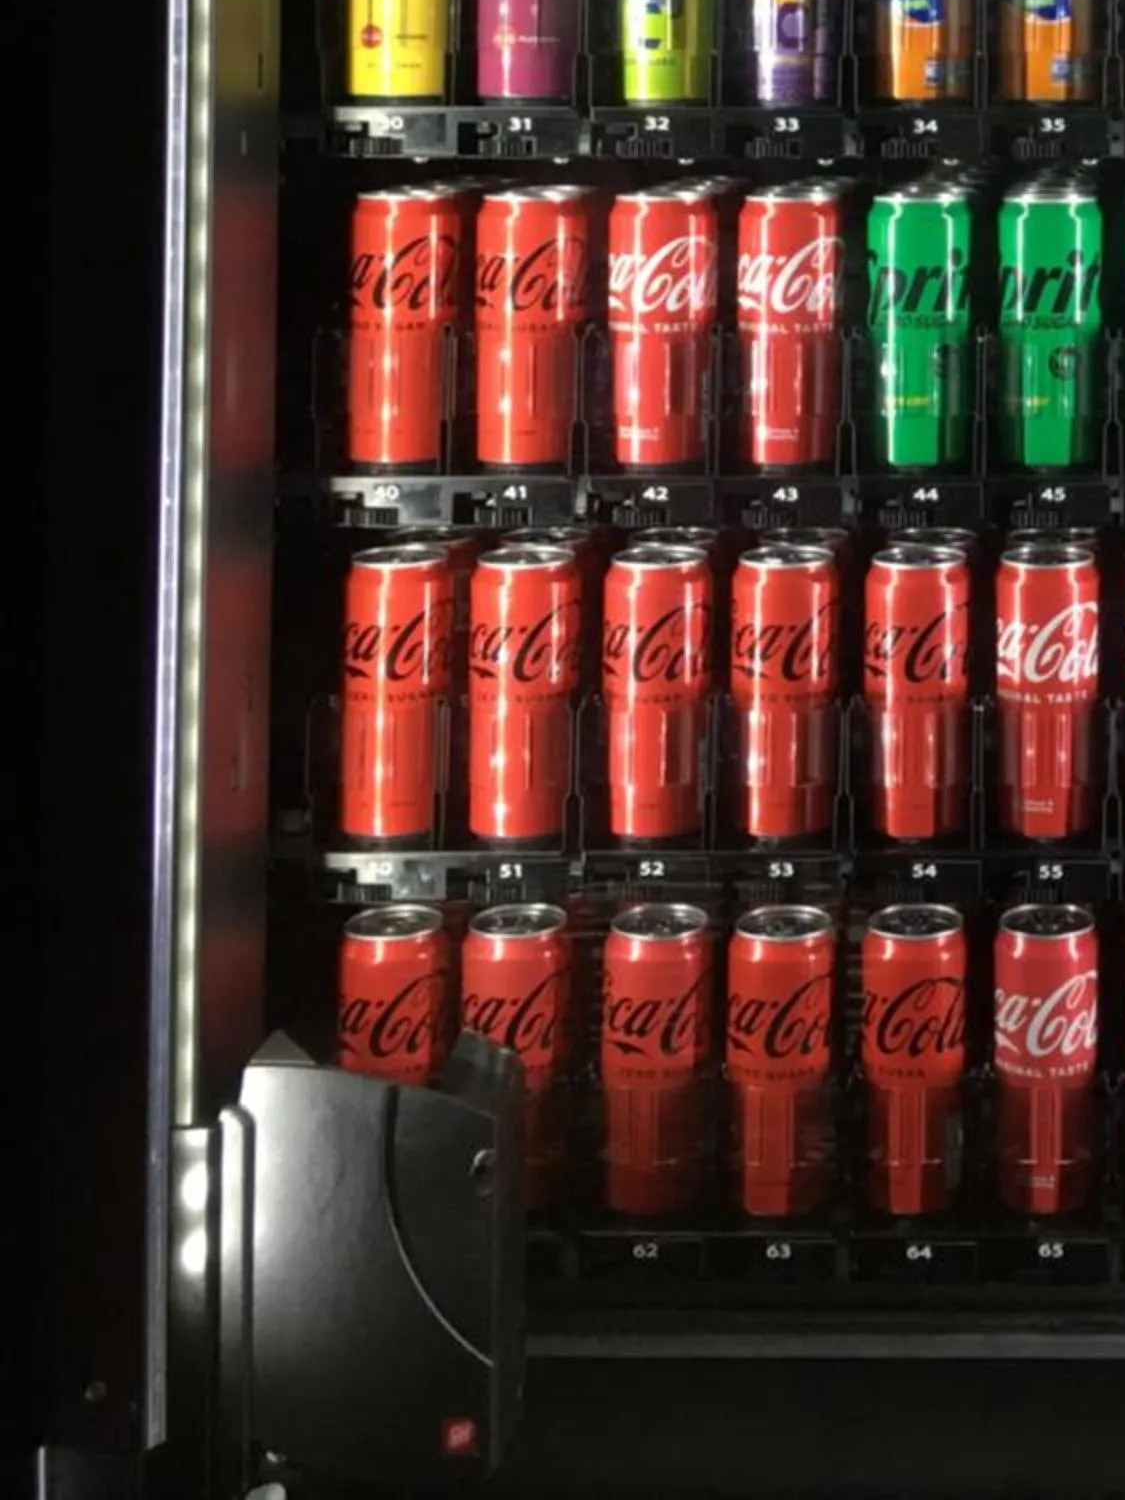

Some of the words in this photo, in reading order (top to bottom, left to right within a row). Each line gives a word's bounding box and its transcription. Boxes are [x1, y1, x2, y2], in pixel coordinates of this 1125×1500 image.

[509, 116, 532, 132] 31
[645, 115, 670, 131] 32
[775, 117, 800, 132] 33
[914, 119, 938, 134] 34
[1041, 117, 1066, 133] 35
[503, 485, 527, 500] 41
[642, 486, 668, 501] 42
[773, 486, 799, 502] 43
[913, 487, 939, 501] 44
[1040, 487, 1066, 502] 45
[499, 863, 522, 879] 51
[639, 861, 664, 877] 52
[769, 862, 794, 878] 53
[912, 863, 937, 879] 54
[1039, 864, 1064, 880] 55
[632, 1242, 659, 1259] 62
[766, 1243, 792, 1259] 63
[906, 1245, 932, 1260] 64
[1038, 1242, 1064, 1258] 65
